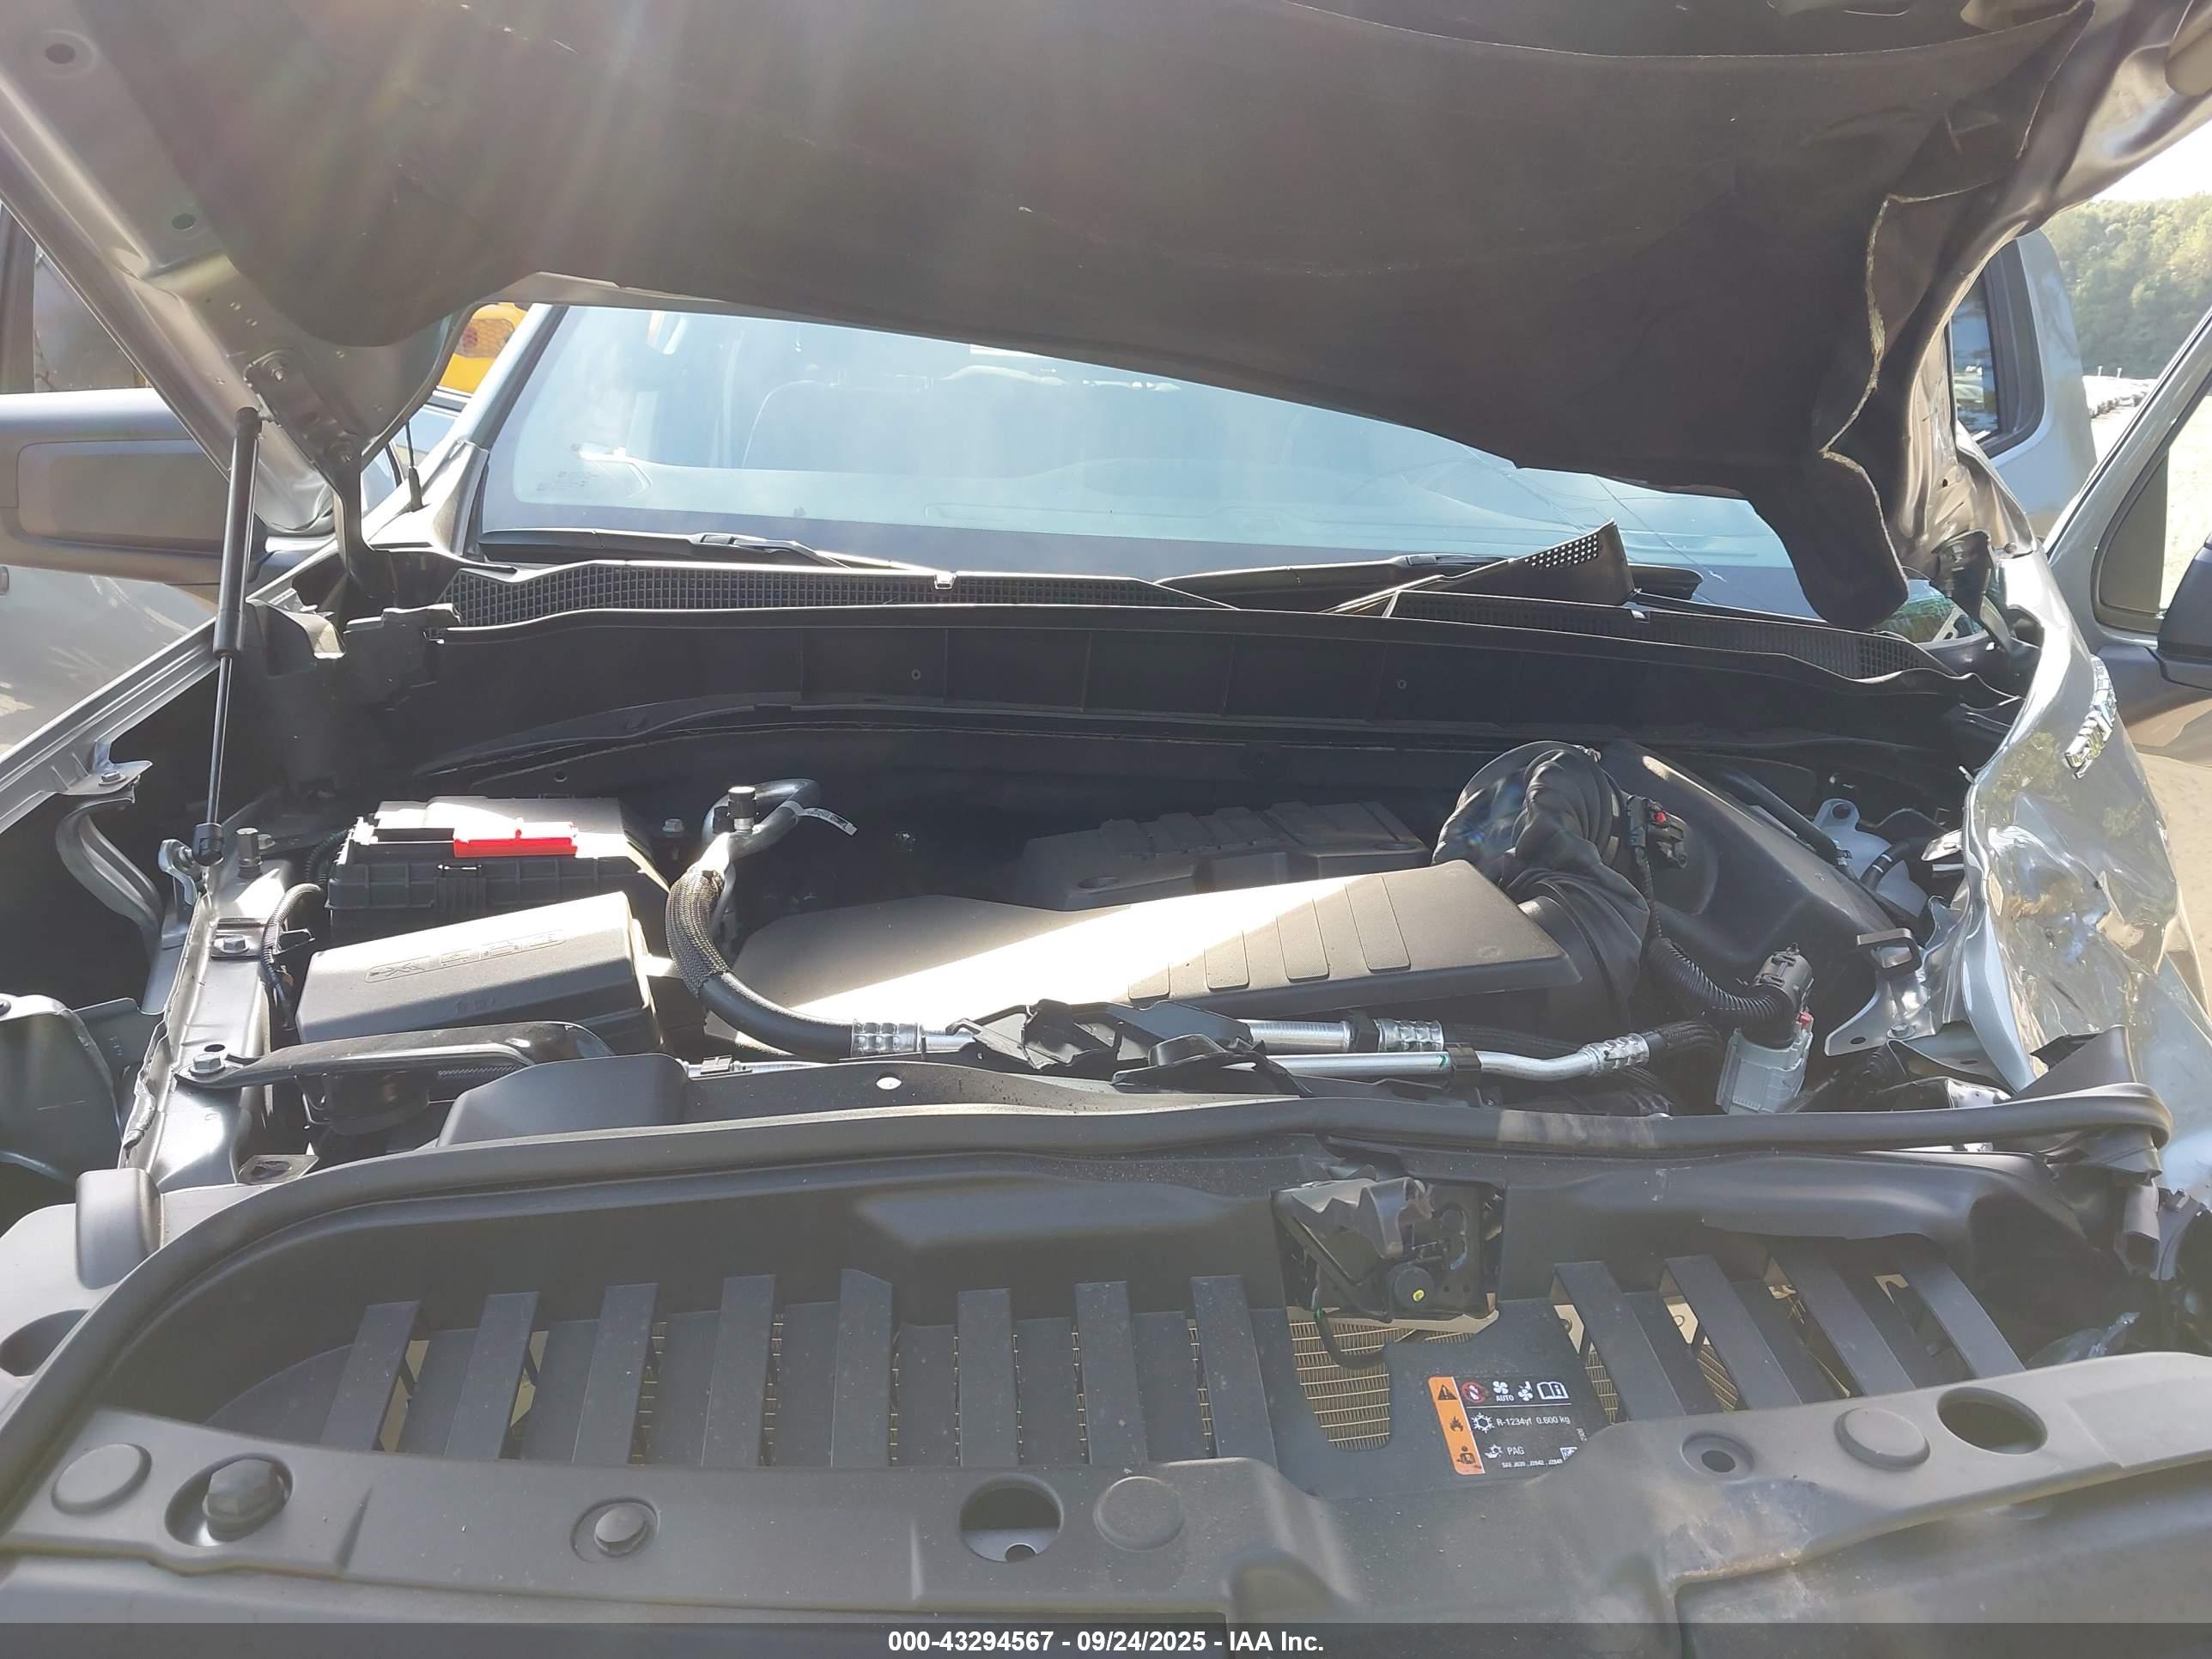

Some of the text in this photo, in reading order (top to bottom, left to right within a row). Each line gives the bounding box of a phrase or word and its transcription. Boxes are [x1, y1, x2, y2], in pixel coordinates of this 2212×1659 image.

[1535, 1416, 1559, 1425] 0.600
[1559, 1415, 1571, 1425] kg
[1507, 1446, 1525, 1455] PAG
